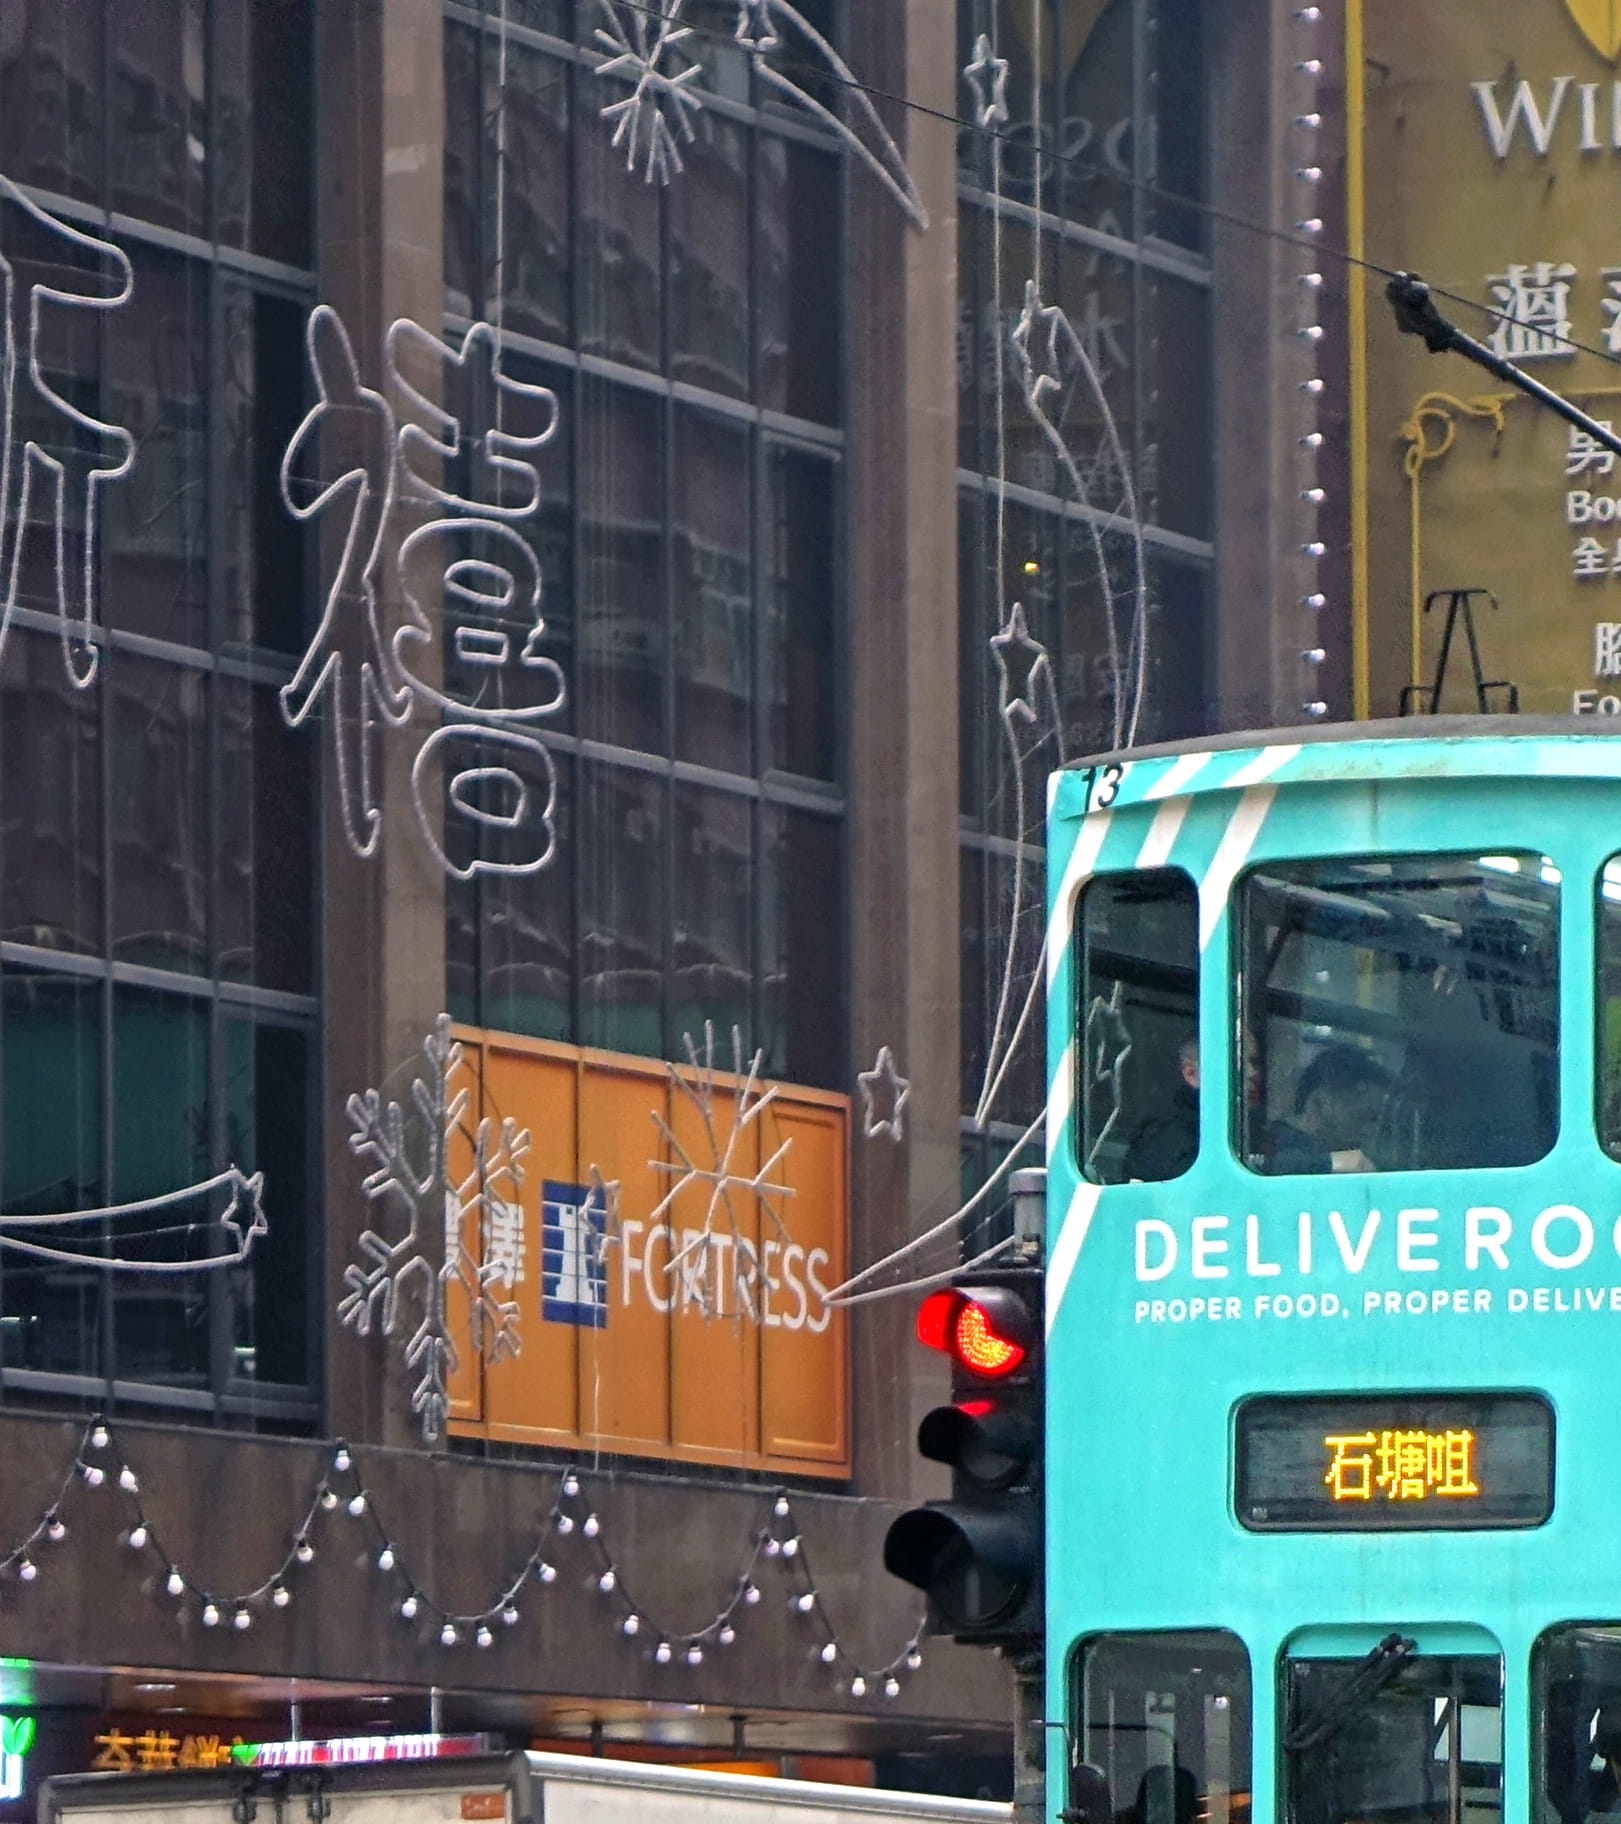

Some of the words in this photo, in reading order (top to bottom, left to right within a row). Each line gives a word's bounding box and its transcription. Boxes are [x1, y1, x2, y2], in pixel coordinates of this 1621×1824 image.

[1083, 765, 1121, 811] 13
[623, 1220, 832, 1333] FORTRESS
[1133, 1298, 1242, 1325] PROPER
[1254, 1293, 1350, 1320] FOOD,
[1363, 1287, 1492, 1317] PROPER
[1325, 1430, 1478, 1499] 石塘咀
